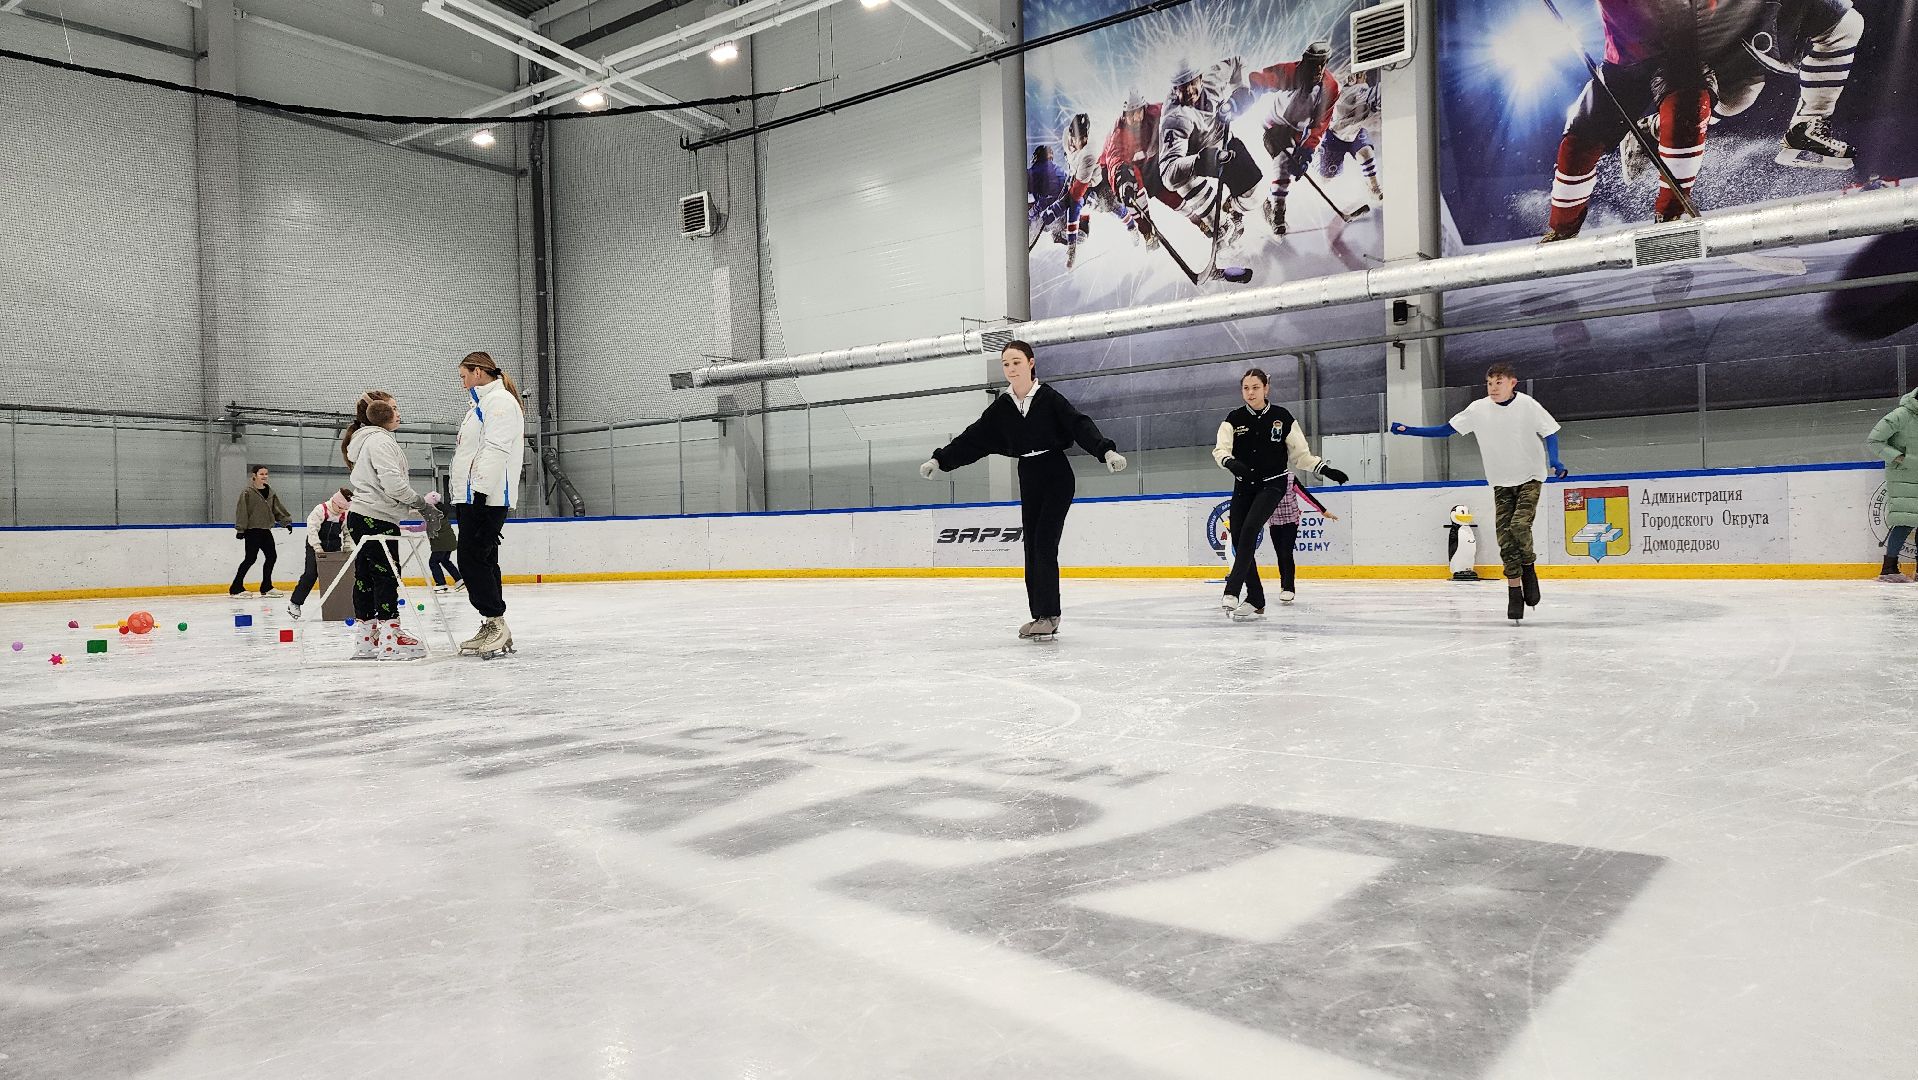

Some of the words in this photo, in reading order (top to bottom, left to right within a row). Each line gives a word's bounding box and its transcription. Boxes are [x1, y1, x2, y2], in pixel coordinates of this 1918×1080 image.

[1640, 488, 1743, 506] Администрация
[1872, 488, 1888, 526] ФЕДЕР
[1641, 512, 1714, 530] Городского
[1722, 509, 1770, 529] Округа
[936, 527, 1025, 544] ЗАРЯ
[1296, 529, 1324, 539] CKEY
[1642, 535, 1720, 554] Домодедово
